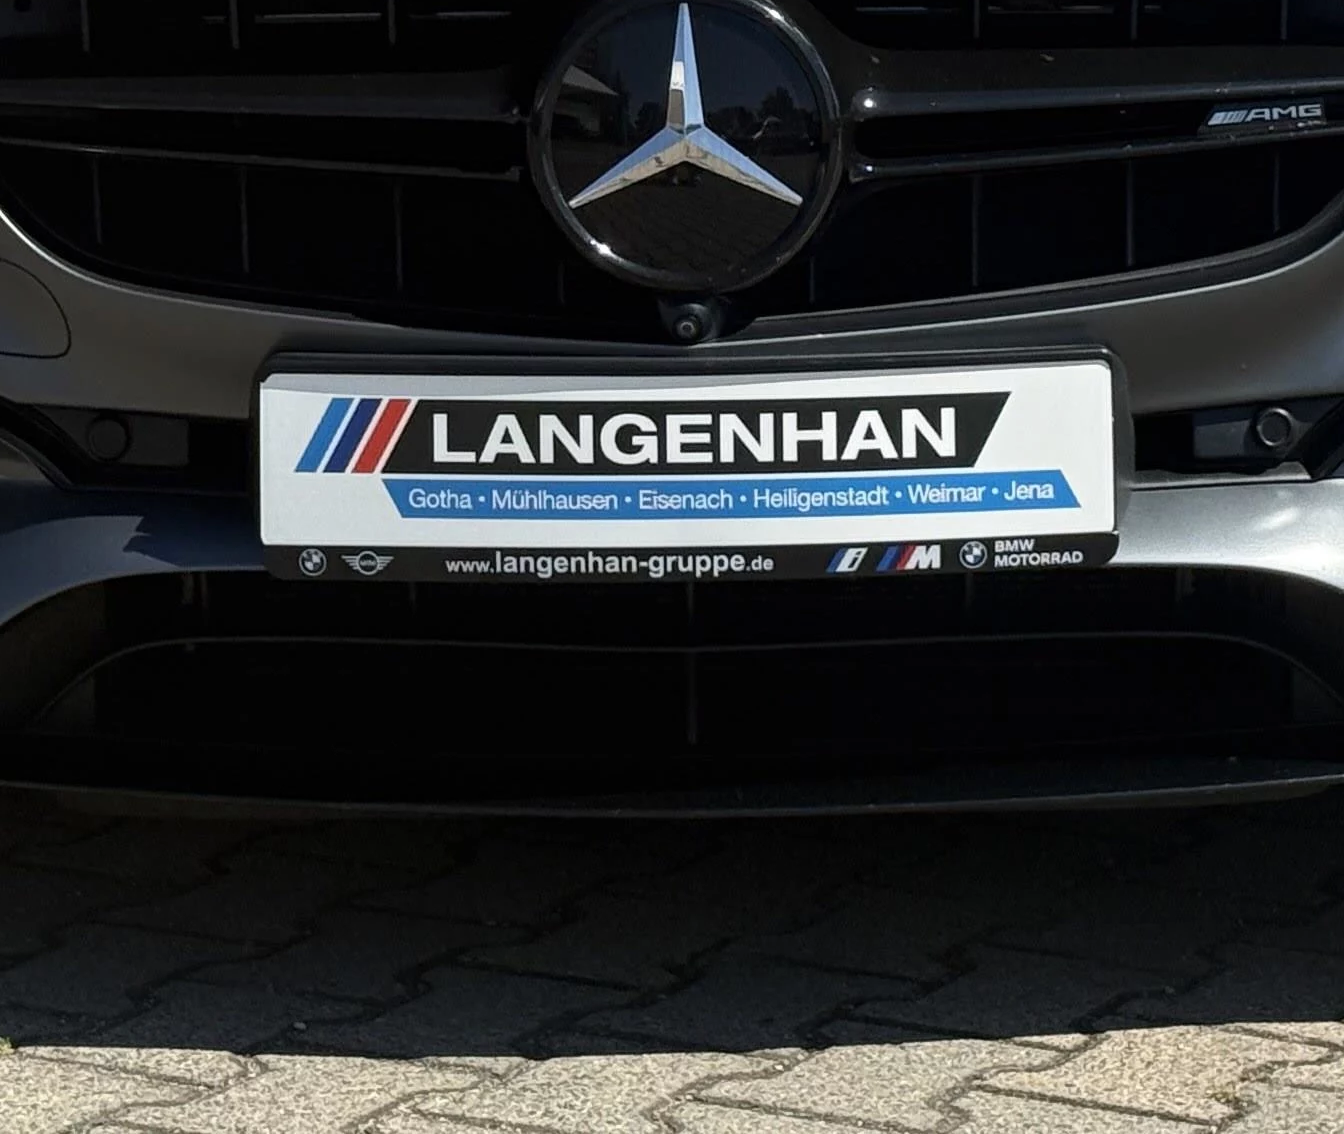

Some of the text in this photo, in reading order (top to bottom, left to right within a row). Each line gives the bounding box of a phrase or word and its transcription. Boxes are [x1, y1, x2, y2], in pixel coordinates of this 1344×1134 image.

[1246, 104, 1322, 121] AMG
[432, 407, 956, 465] LANGENHAN
[408, 481, 1055, 514] Gotha Mühlhausen Eisenach Heiligenstadt Weimar Jena
[994, 539, 1035, 554] BMW
[445, 550, 775, 577] www.langenhan-gruppe.de
[994, 551, 1084, 567] MOTORRAD
